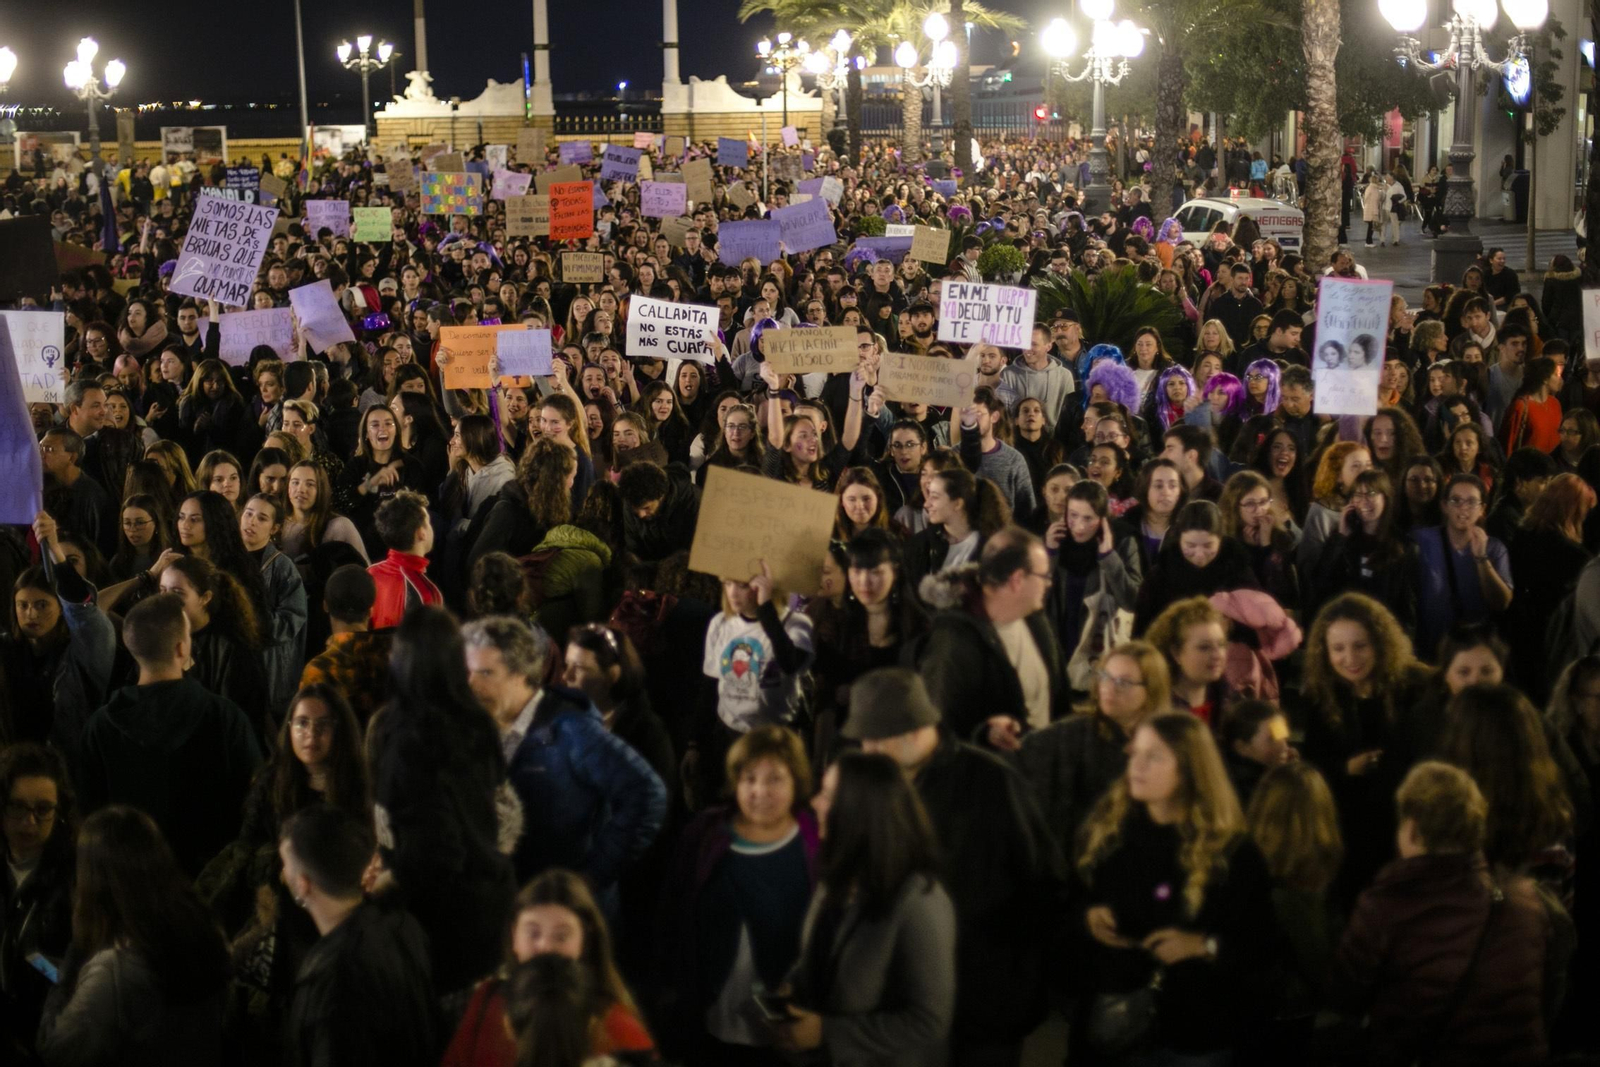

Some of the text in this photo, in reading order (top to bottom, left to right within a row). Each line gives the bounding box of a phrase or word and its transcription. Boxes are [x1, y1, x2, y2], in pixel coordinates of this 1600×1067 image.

[201, 187, 255, 204] MANOLO
[554, 186, 564, 195] NO
[201, 200, 275, 229] SOMOS LAS
[553, 211, 575, 220] FALTAN
[191, 216, 259, 240] NIETAS DE
[185, 235, 262, 267] BRUJAS QUE
[236, 237, 260, 249] LAS
[208, 263, 221, 277] NO
[193, 275, 249, 305] QUEMAR
[948, 284, 968, 300] EN
[997, 287, 1029, 308] CUERPO
[638, 304, 707, 325] CALLADITA
[943, 301, 1022, 324] YO DECIDO Y TU
[234, 313, 280, 331] REBELO
[447, 330, 459, 340] De
[639, 323, 703, 340] NO ESTÁS
[950, 321, 1022, 346] TE CALLAS
[638, 336, 713, 356] MÁS GUAPA
[805, 354, 834, 365] SOLO
[908, 358, 951, 374] NOSOTRAS
[455, 366, 465, 374] no
[896, 383, 907, 394] SE
[930, 375, 953, 385] MUNDO
[43, 391, 58, 403] 8M
